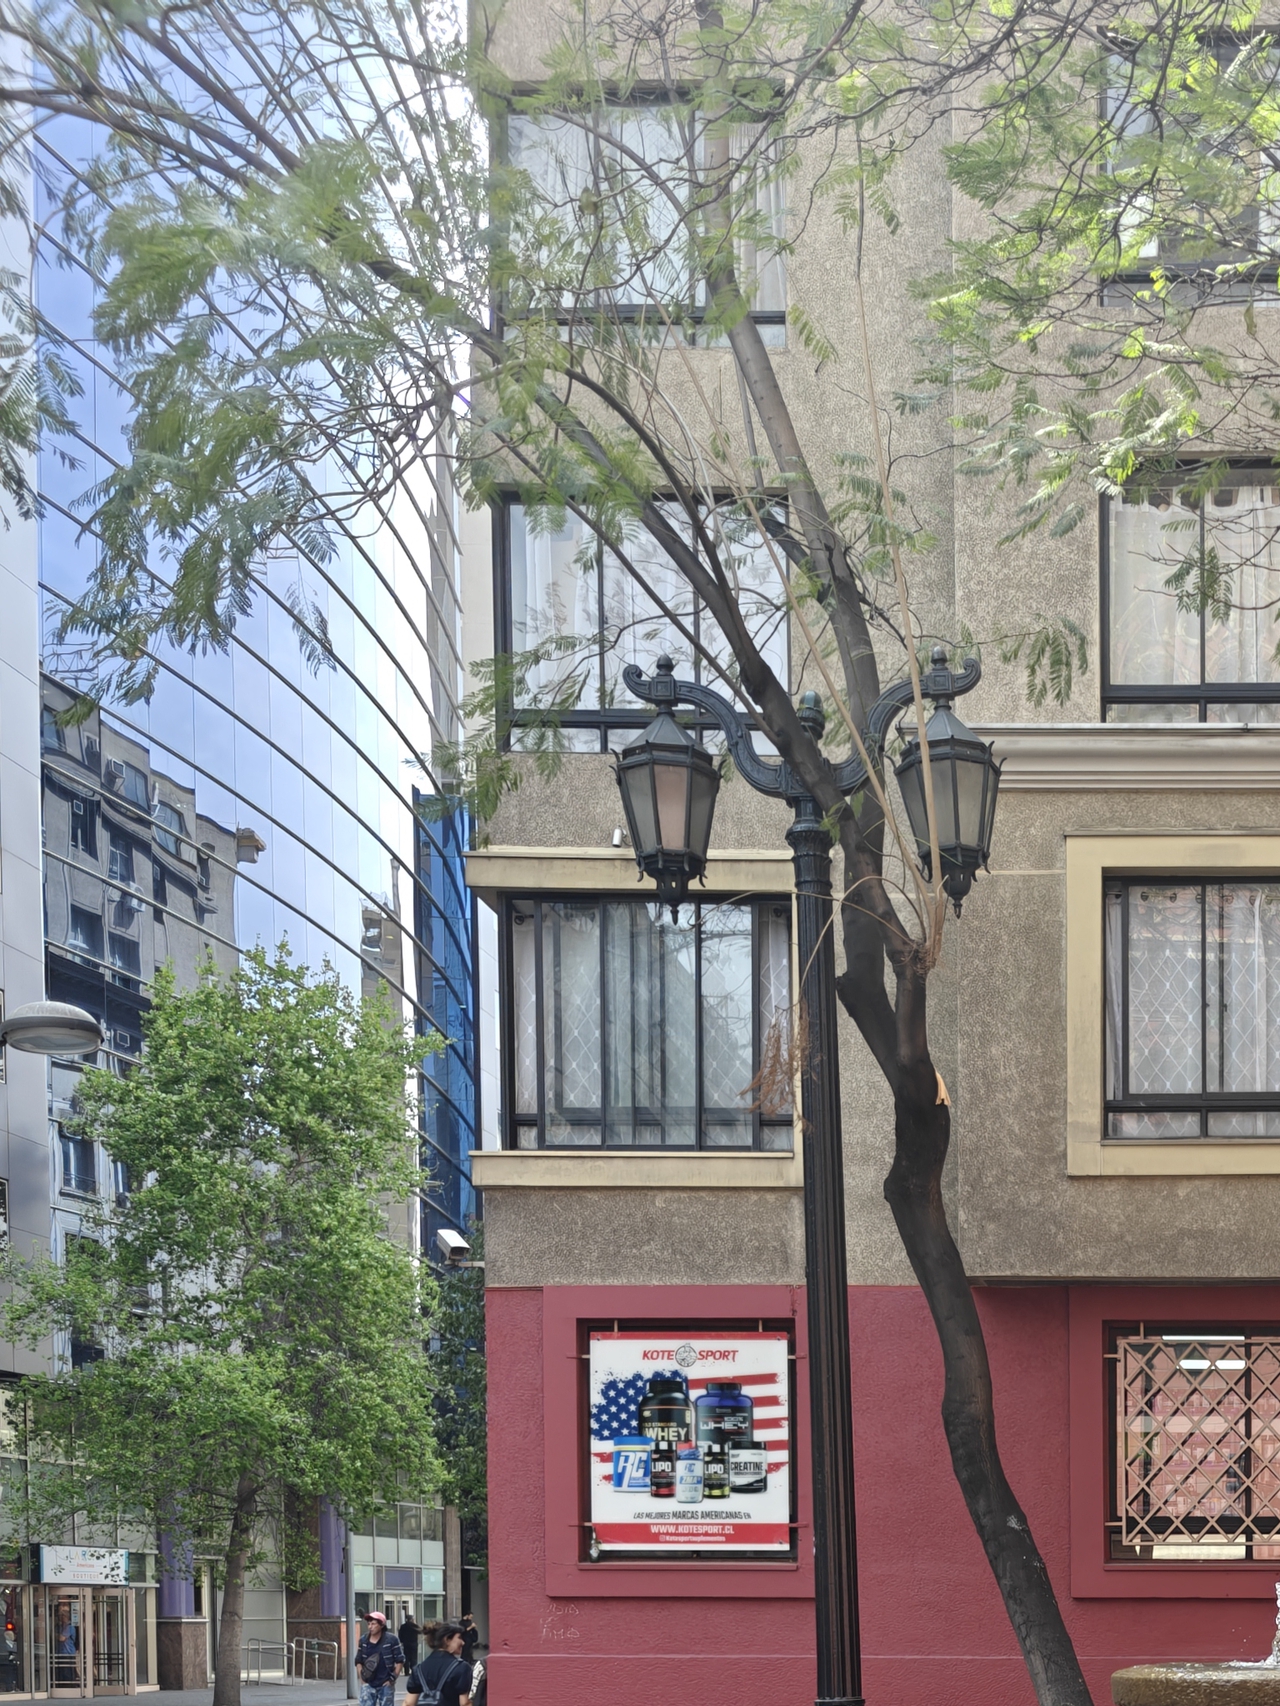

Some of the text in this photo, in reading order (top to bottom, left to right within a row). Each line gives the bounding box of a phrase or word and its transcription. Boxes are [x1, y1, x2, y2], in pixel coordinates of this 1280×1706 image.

[642, 1349, 739, 1362] KOTE SPORT
[700, 1421, 749, 1430] WHEY
[645, 1427, 687, 1441] WHEY
[651, 1462, 671, 1472] LIPO
[704, 1463, 724, 1474] LIPO
[730, 1461, 763, 1472] CREATINE
[633, 1511, 645, 1519] LAS
[645, 1511, 671, 1519] MEJORES
[671, 1510, 699, 1520] MARCAS
[700, 1510, 743, 1520] AMERICANAS
[650, 1524, 735, 1534] WWW.KOTESPORT.CL
